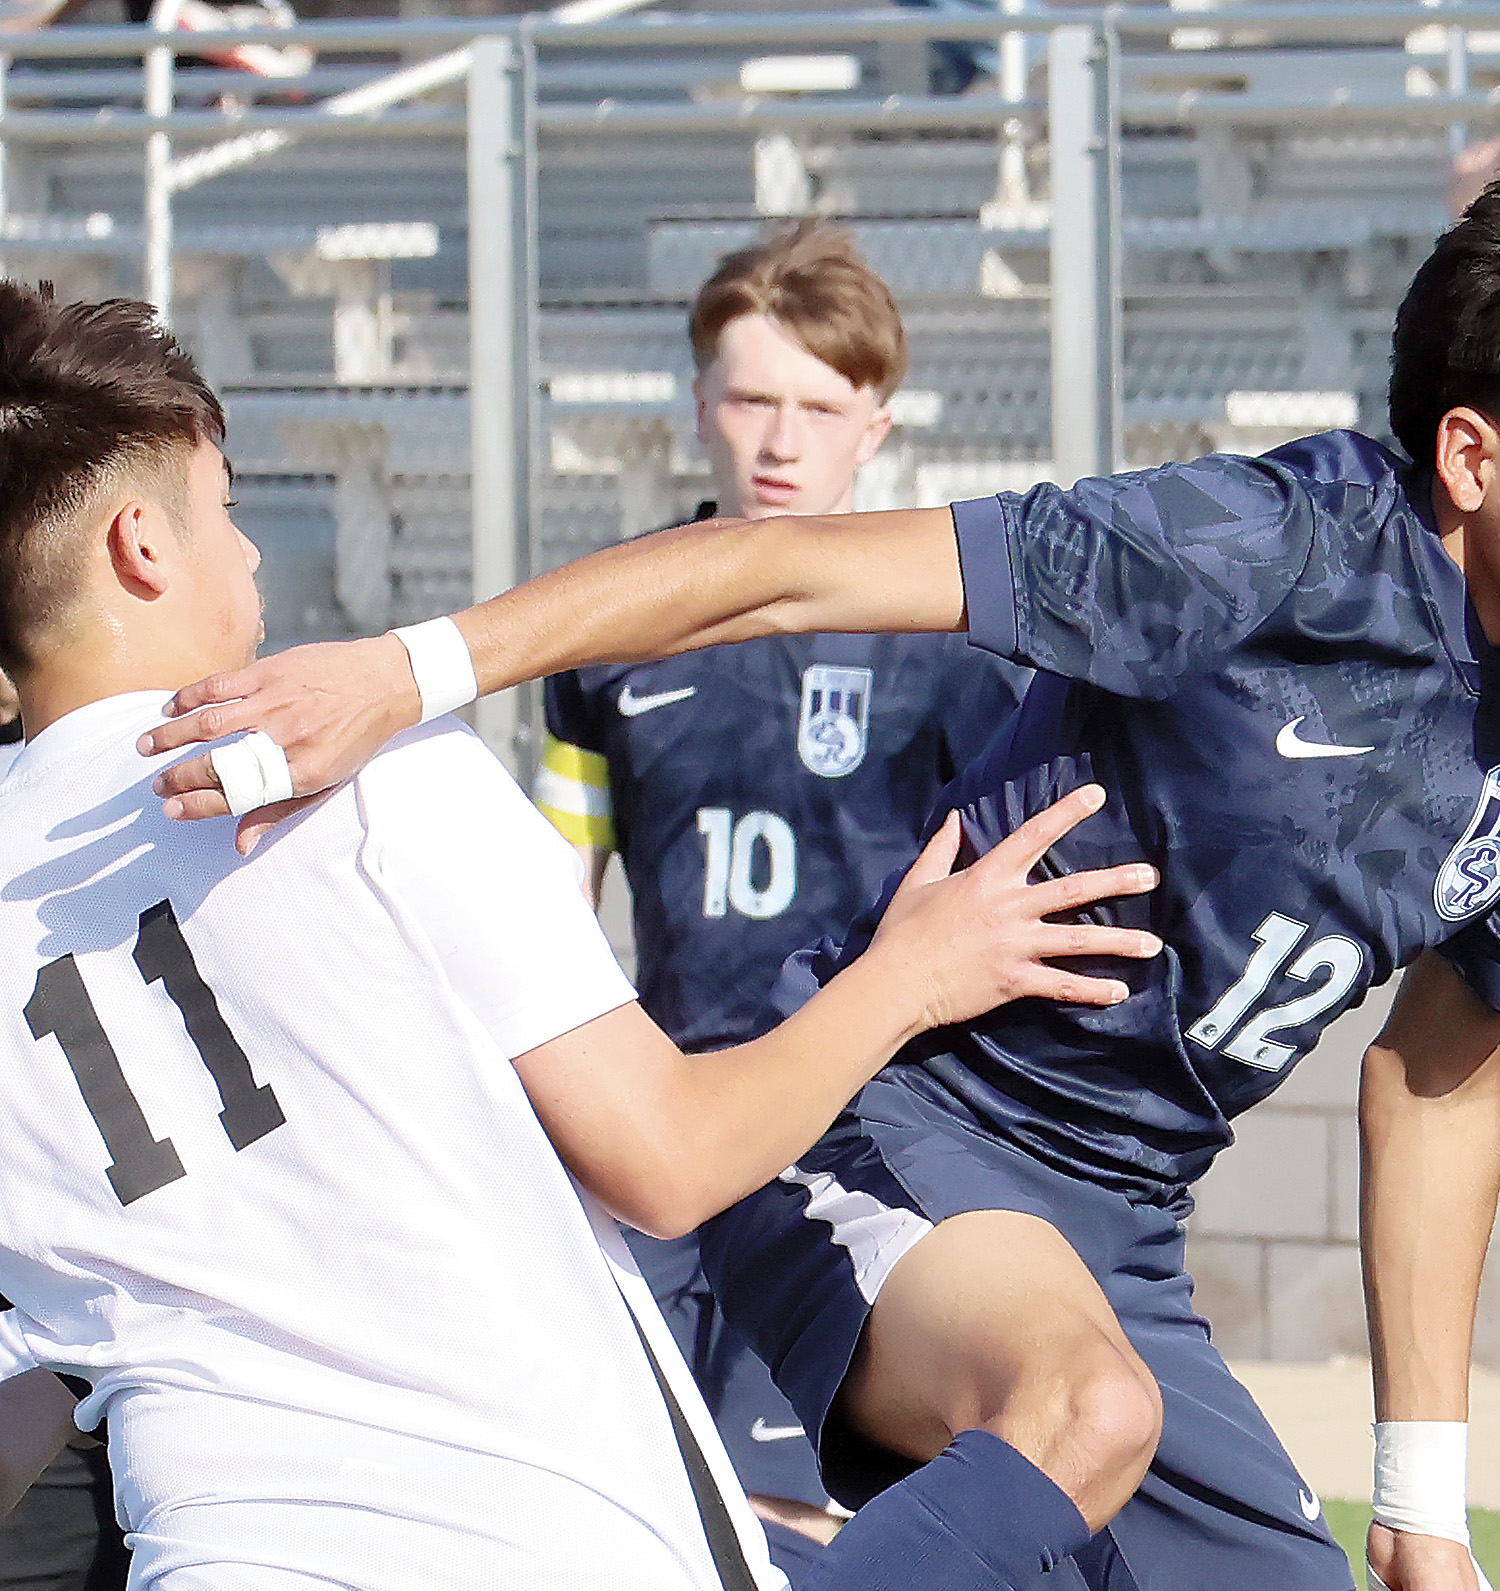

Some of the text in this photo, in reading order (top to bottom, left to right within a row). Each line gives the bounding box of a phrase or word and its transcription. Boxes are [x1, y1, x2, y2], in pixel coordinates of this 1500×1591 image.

[696, 806, 798, 920] 10
[23, 898, 287, 1207] 11
[1184, 910, 1364, 1073] 12
